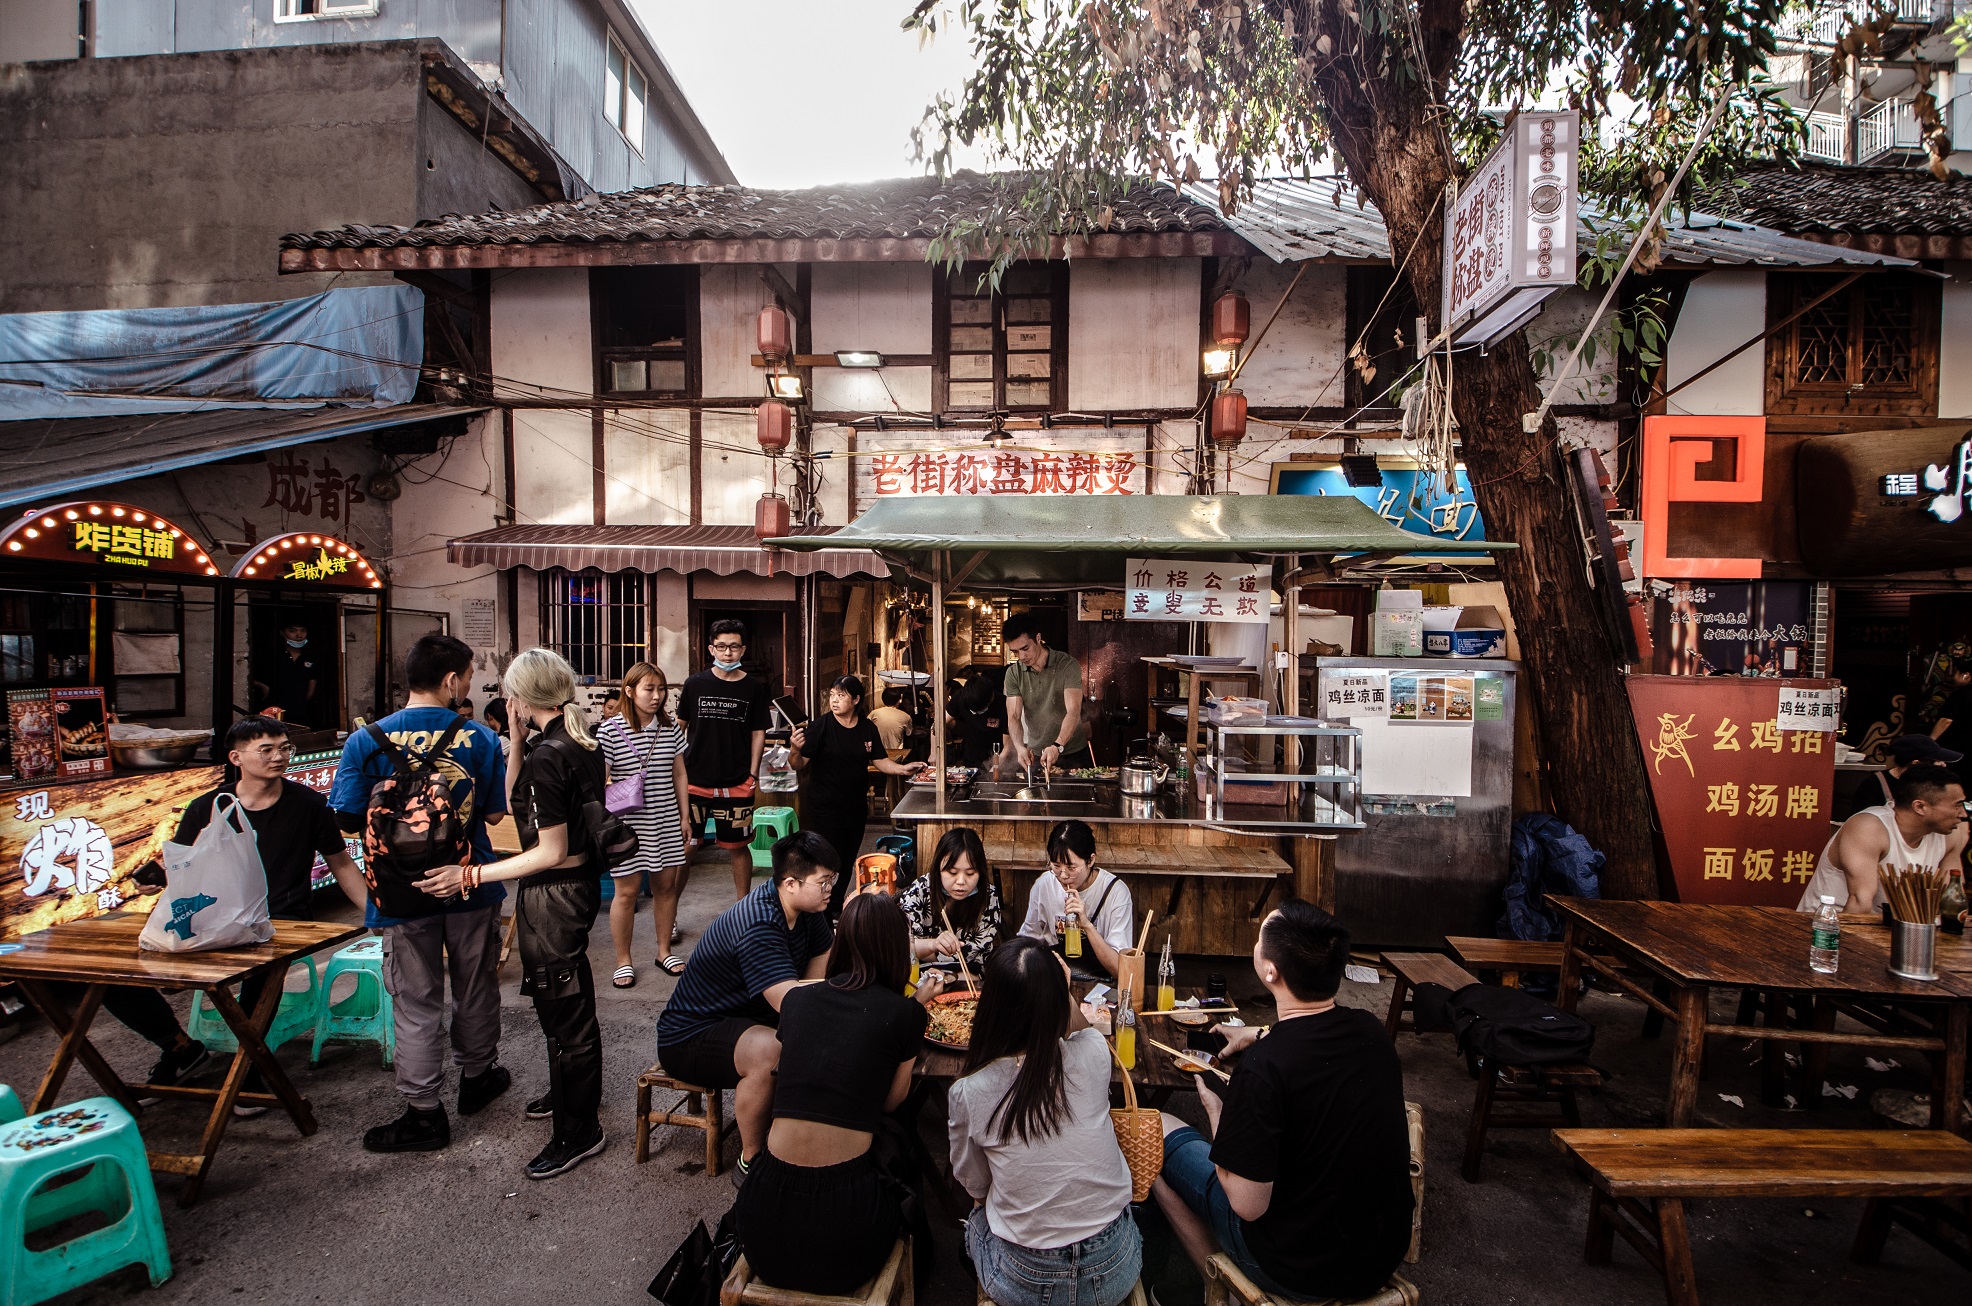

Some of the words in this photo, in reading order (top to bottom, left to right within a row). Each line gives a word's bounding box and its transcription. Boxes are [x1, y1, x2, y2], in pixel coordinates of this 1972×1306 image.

[1453, 187, 1485, 263] 老街
[871, 451, 1135, 496] 老街称盘麻辣烫
[1885, 474, 1918, 496] 程
[261, 450, 365, 533] 成都
[75, 522, 174, 560] 炸货铺
[104, 554, 121, 563] ZHA
[137, 558, 149, 567] PU
[1133, 568, 1260, 594] 价格公道
[1131, 589, 1259, 616] 童叟无欺
[1343, 678, 1368, 686] 夏日新品
[1328, 688, 1385, 705] 鸡丝凉面
[1780, 700, 1833, 718] 鸡丝凉面
[1741, 718, 1785, 882] 鸡汤饭
